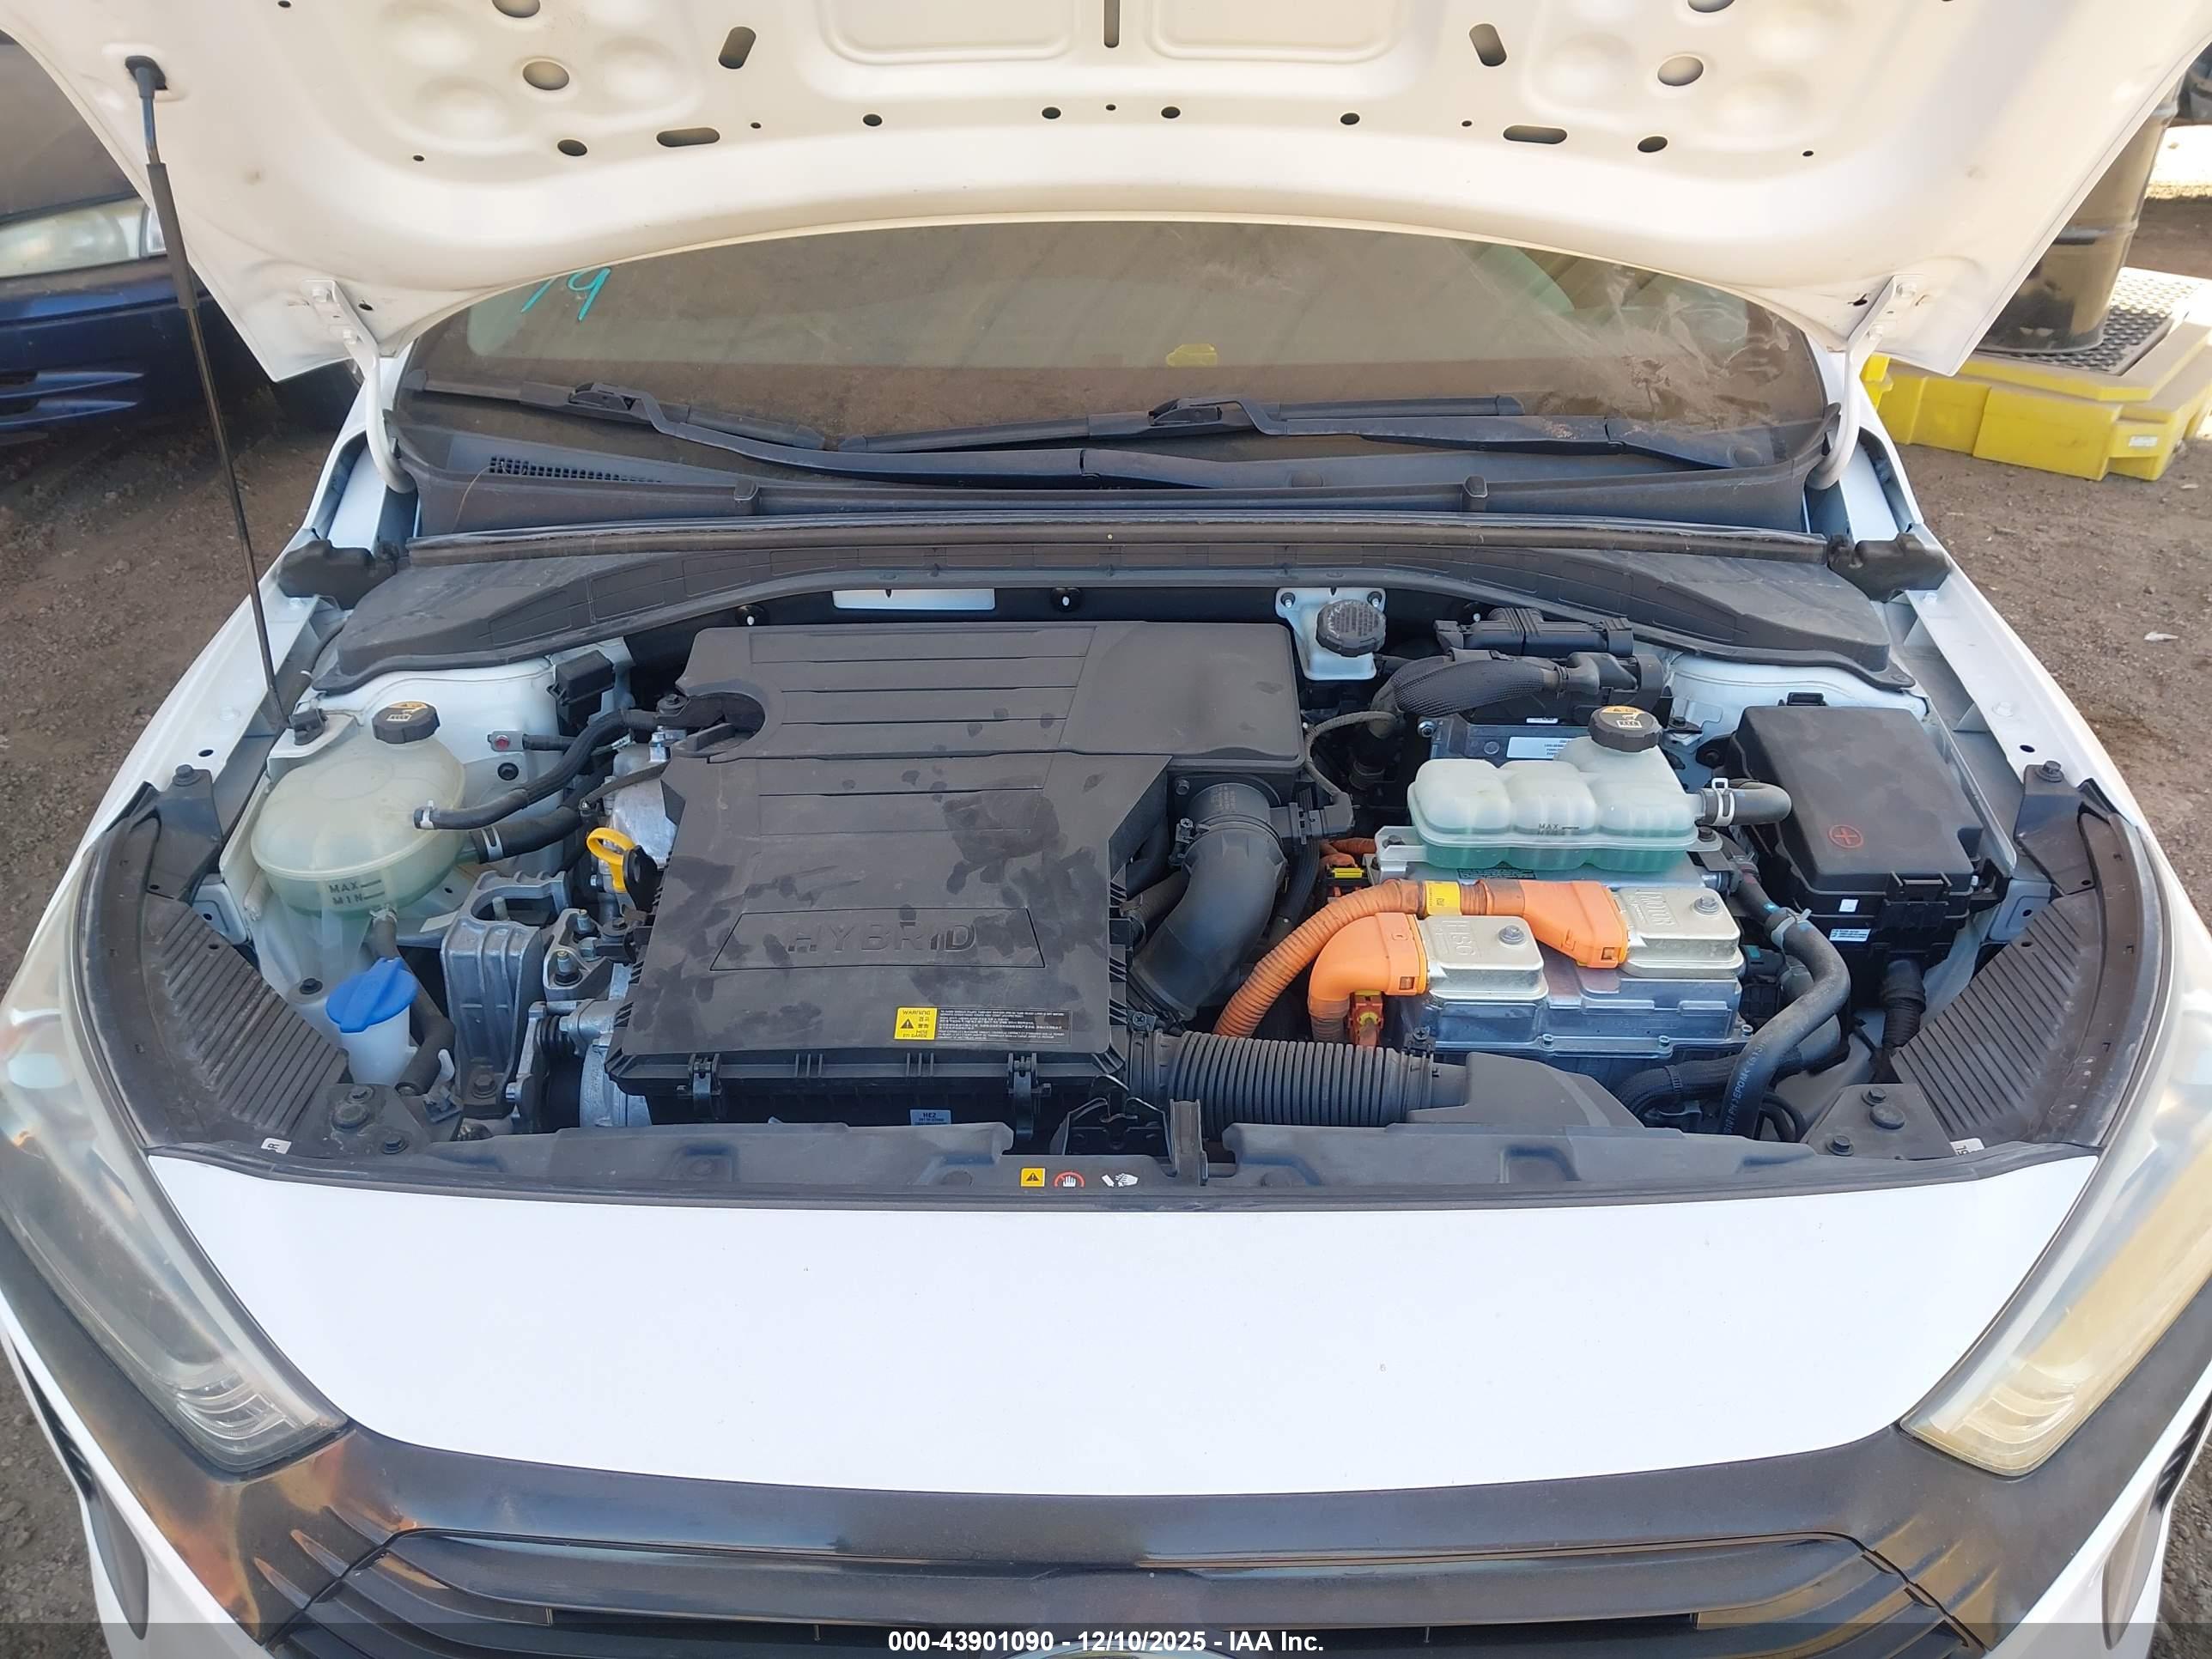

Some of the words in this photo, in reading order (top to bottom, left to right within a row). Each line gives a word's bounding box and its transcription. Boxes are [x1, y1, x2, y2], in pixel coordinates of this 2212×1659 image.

[329, 881, 358, 893] MAX
[332, 894, 362, 904] MIN
[787, 924, 976, 951] HYBRID
